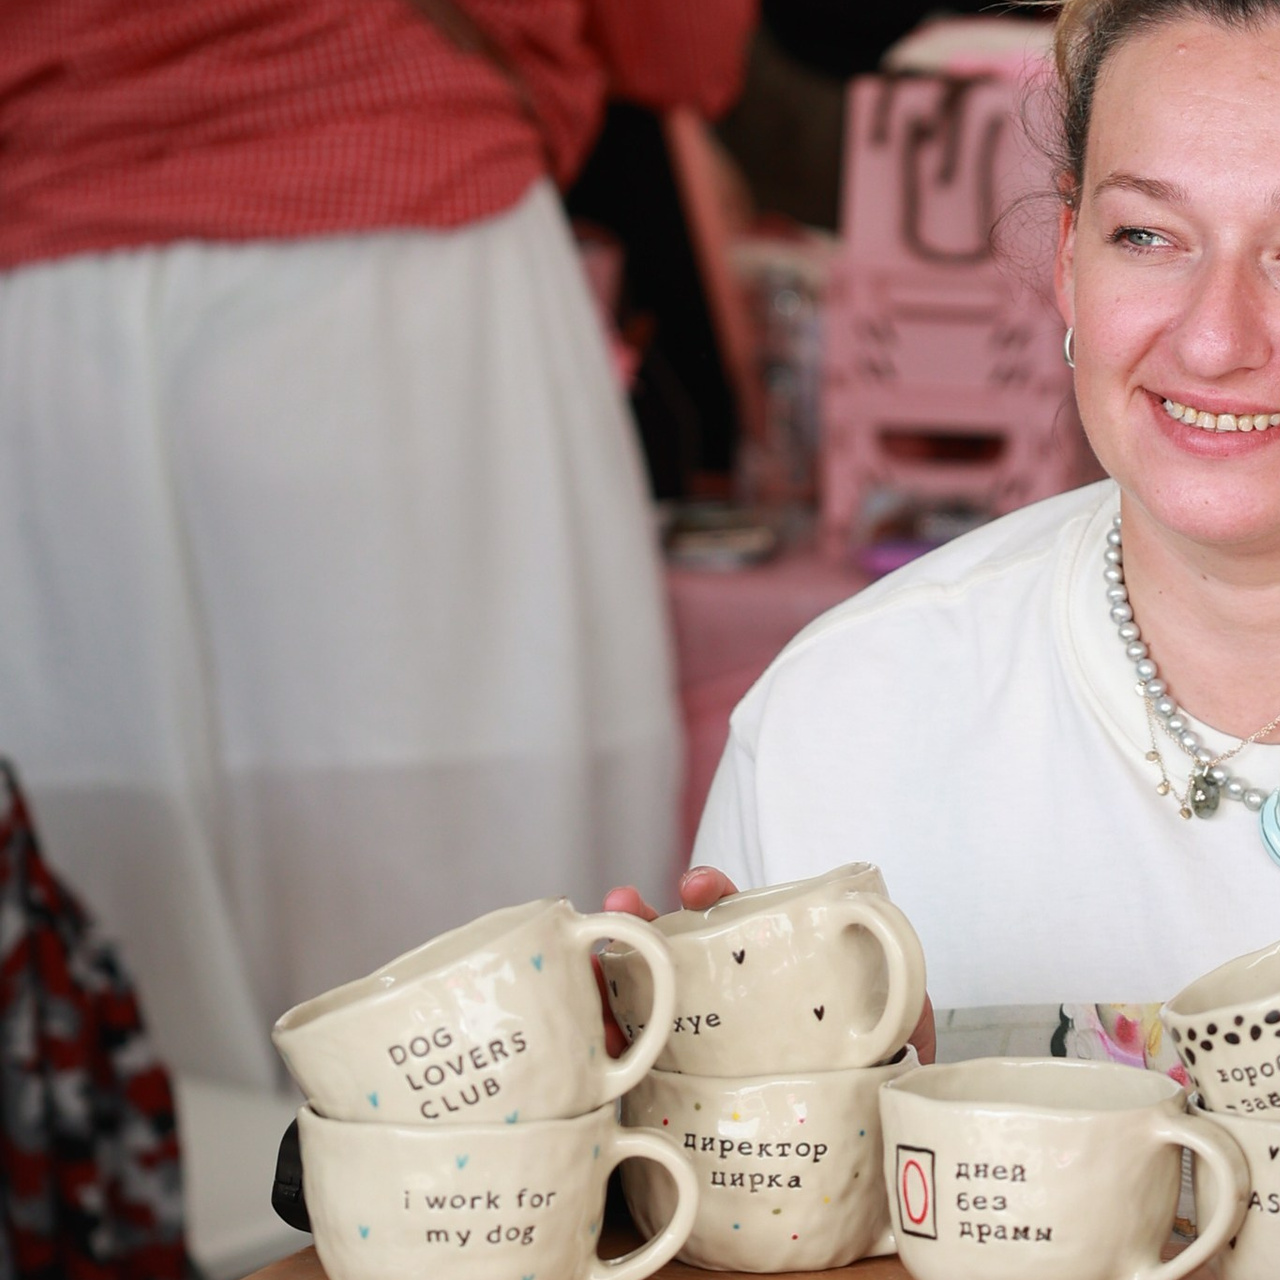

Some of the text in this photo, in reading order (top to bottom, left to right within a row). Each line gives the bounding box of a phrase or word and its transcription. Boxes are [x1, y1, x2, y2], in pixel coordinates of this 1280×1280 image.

[388, 1027, 453, 1066] DOG
[406, 1031, 527, 1091] LOVERS
[420, 1077, 501, 1119] CLUB
[683, 1133, 828, 1163] директор
[711, 1171, 802, 1193] цирка
[955, 1162, 1027, 1182] дней
[404, 1188, 556, 1210] i work for
[956, 1192, 1007, 1211] без
[426, 1224, 535, 1247] my dog
[959, 1221, 1053, 1243] драмы
